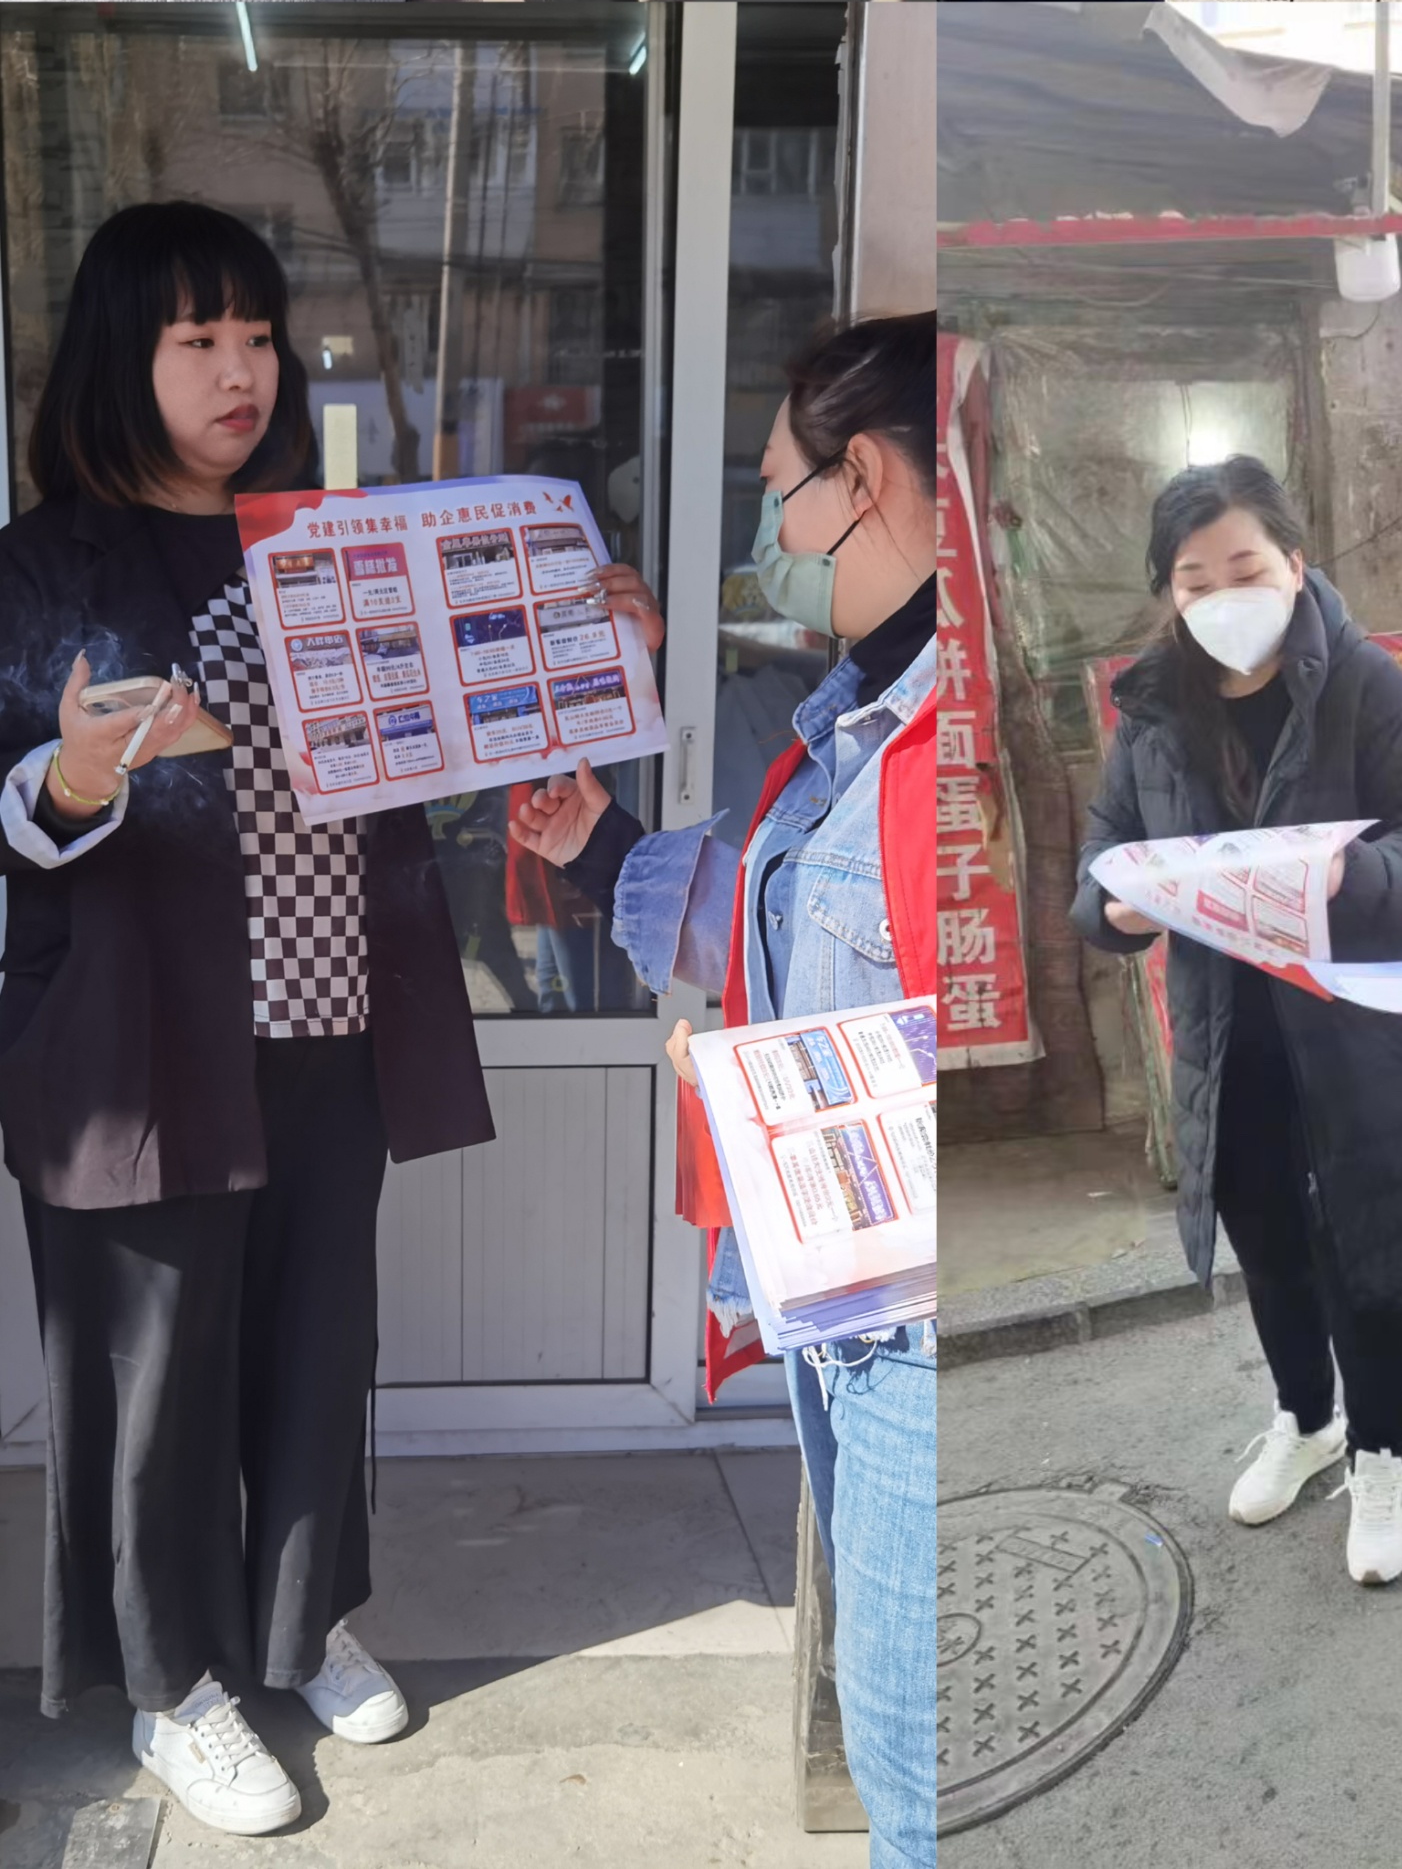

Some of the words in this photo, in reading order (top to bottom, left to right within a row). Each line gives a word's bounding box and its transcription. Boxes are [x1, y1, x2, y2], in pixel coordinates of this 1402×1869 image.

[307, 514, 408, 539] 党建引领集幸福
[421, 500, 538, 528] 助企惠民促消费
